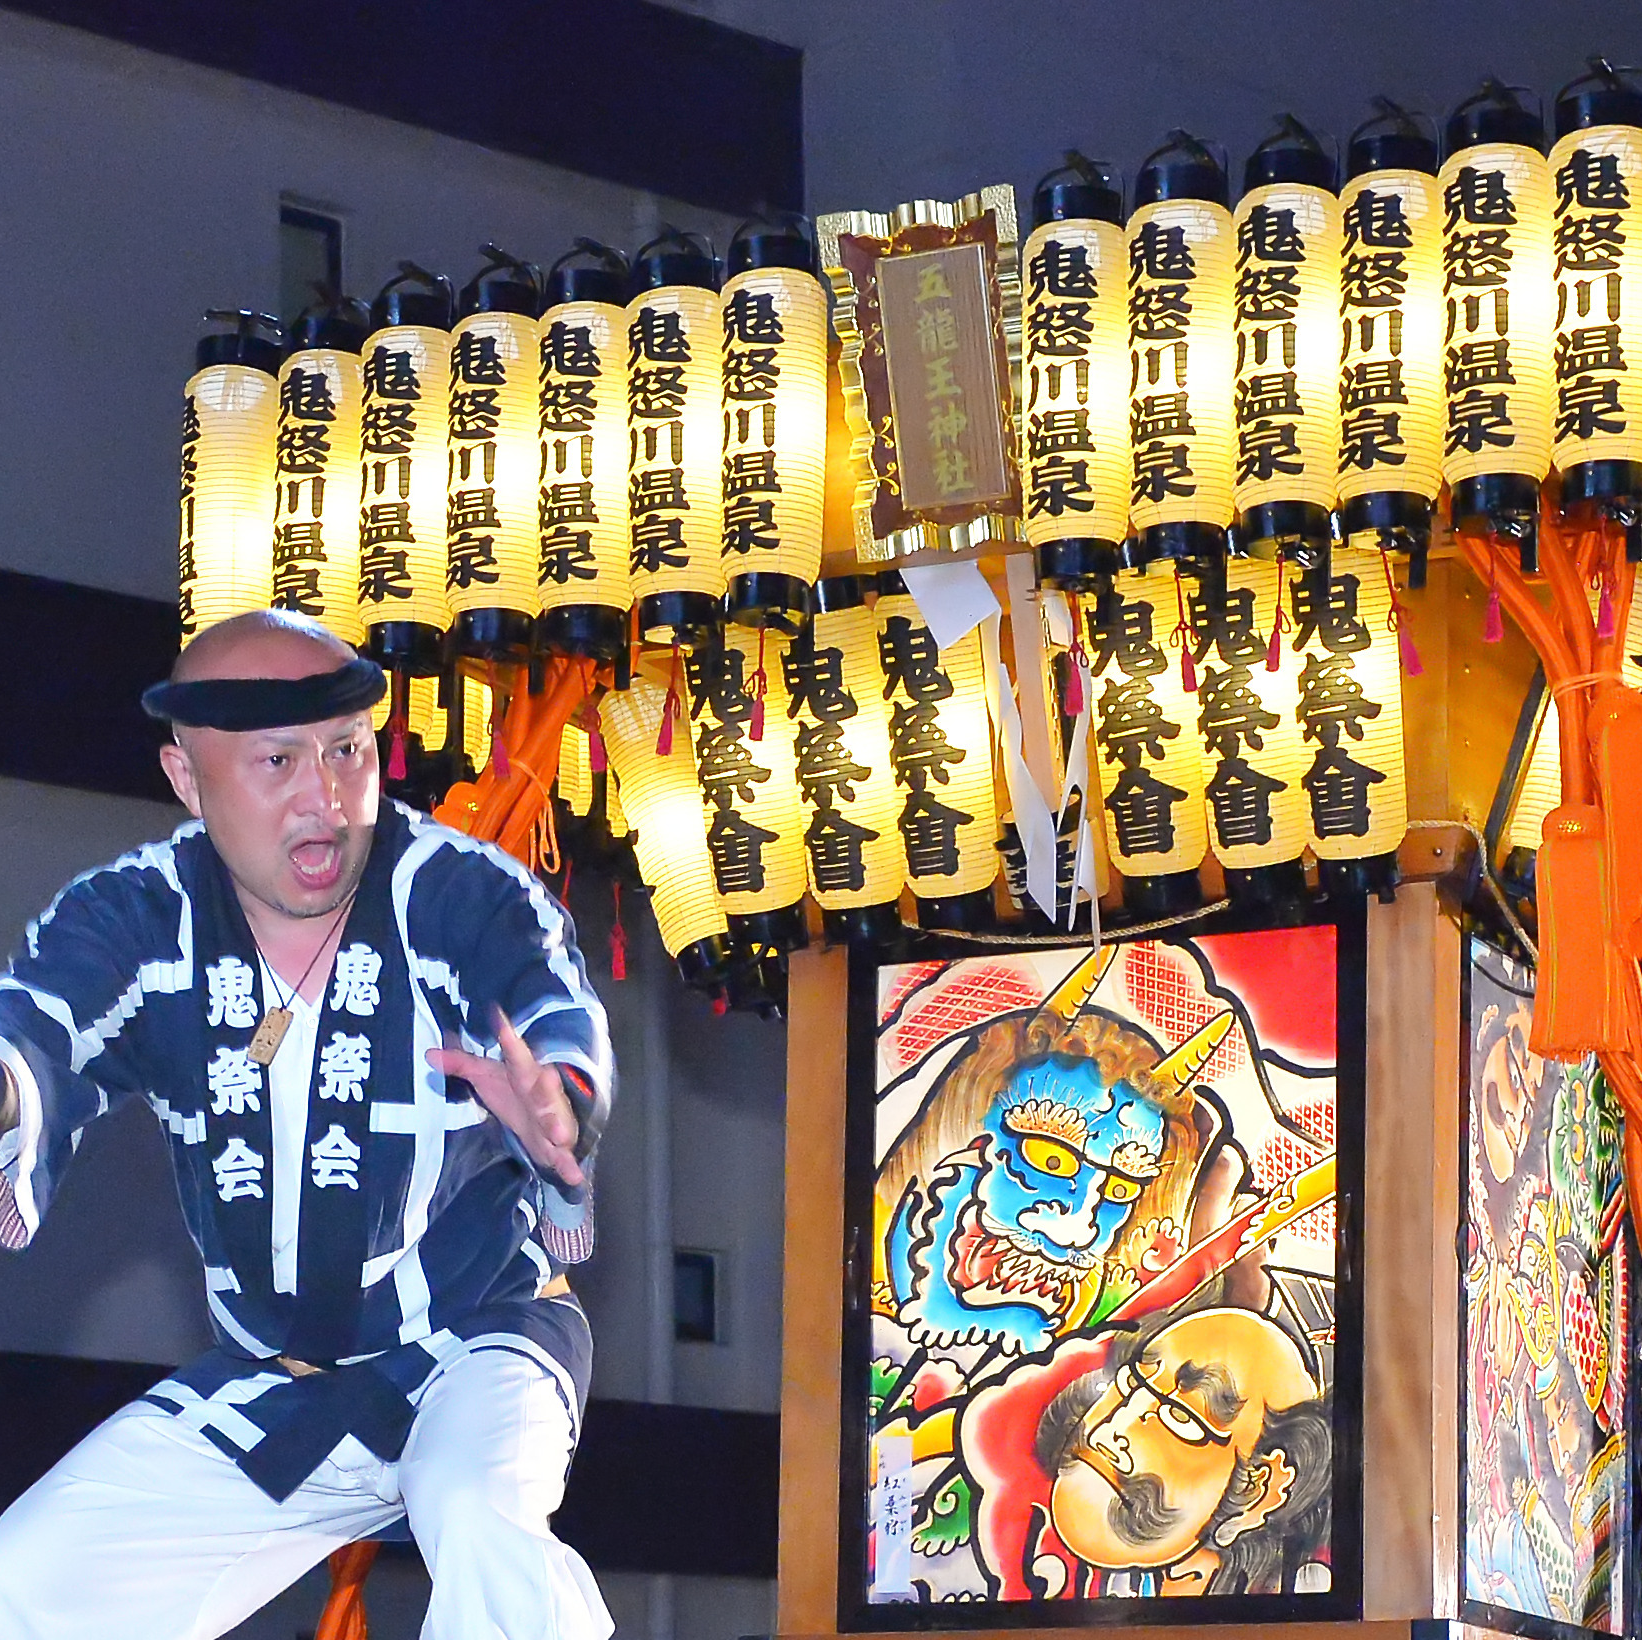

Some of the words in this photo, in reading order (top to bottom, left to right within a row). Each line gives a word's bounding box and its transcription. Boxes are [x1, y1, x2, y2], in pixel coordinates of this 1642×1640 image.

[721, 289, 784, 554] 鬼怒川温泉
[914, 262, 975, 496] 五龍王神社
[1027, 240, 1098, 519] 鬼怒川温泉
[1128, 221, 1196, 505] 鬼怒川温泉
[1235, 204, 1306, 484] 鬼怒川温泉
[1338, 189, 1413, 470] 鬼怒川温泉
[1443, 166, 1517, 456] 鬼怒川温泉
[1553, 149, 1631, 440] 鬼怒川温泉
[271, 368, 336, 616] 鬼怒川温泉
[359, 345, 421, 601] 鬼怒川温泉
[446, 331, 507, 589] 鬼怒川温泉
[537, 322, 601, 582] 鬼怒川温泉
[628, 307, 691, 573] 鬼怒川温泉
[205, 957, 264, 1202] 鬼祭会
[310, 943, 383, 1191] 鬼祭会
